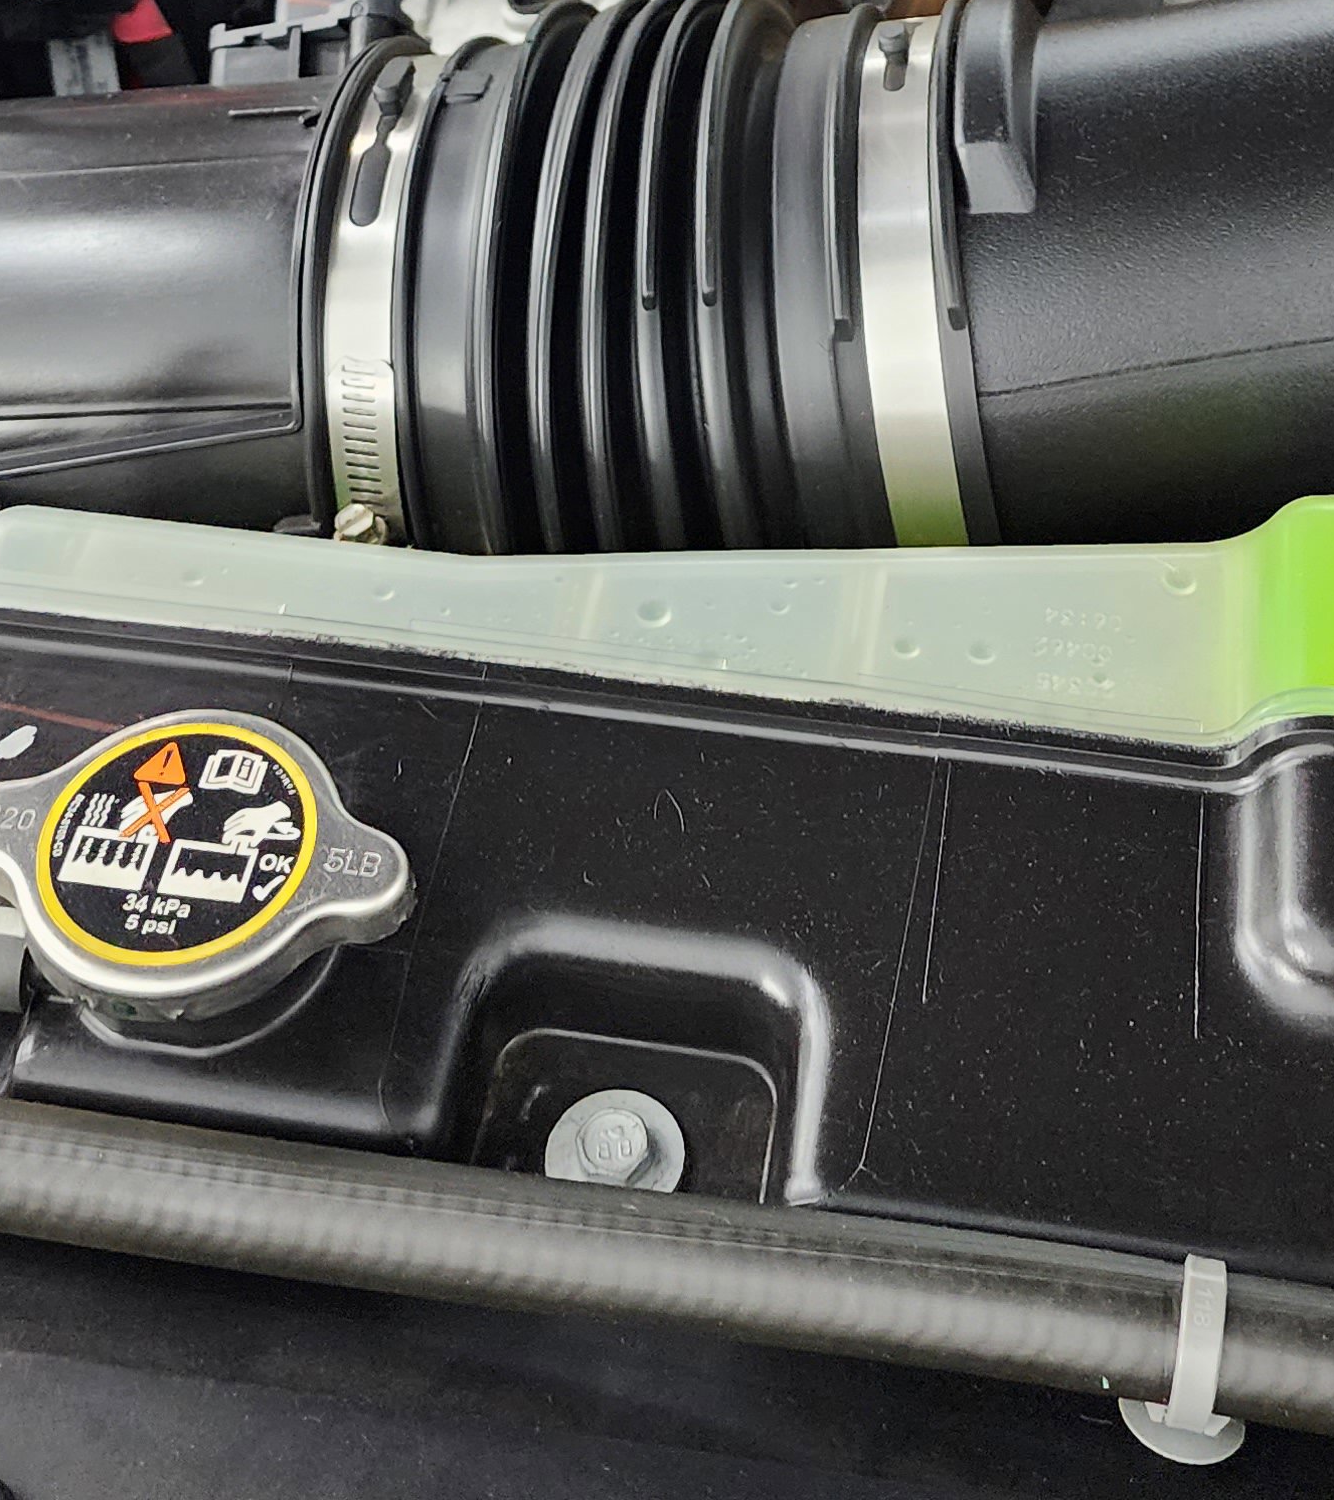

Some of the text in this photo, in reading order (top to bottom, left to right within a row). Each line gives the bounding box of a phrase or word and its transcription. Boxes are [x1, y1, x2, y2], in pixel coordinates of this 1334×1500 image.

[259, 853, 295, 874] OK
[322, 846, 383, 879] 5LB
[122, 892, 192, 918] 34 kPa
[124, 914, 177, 935] 5 psi
